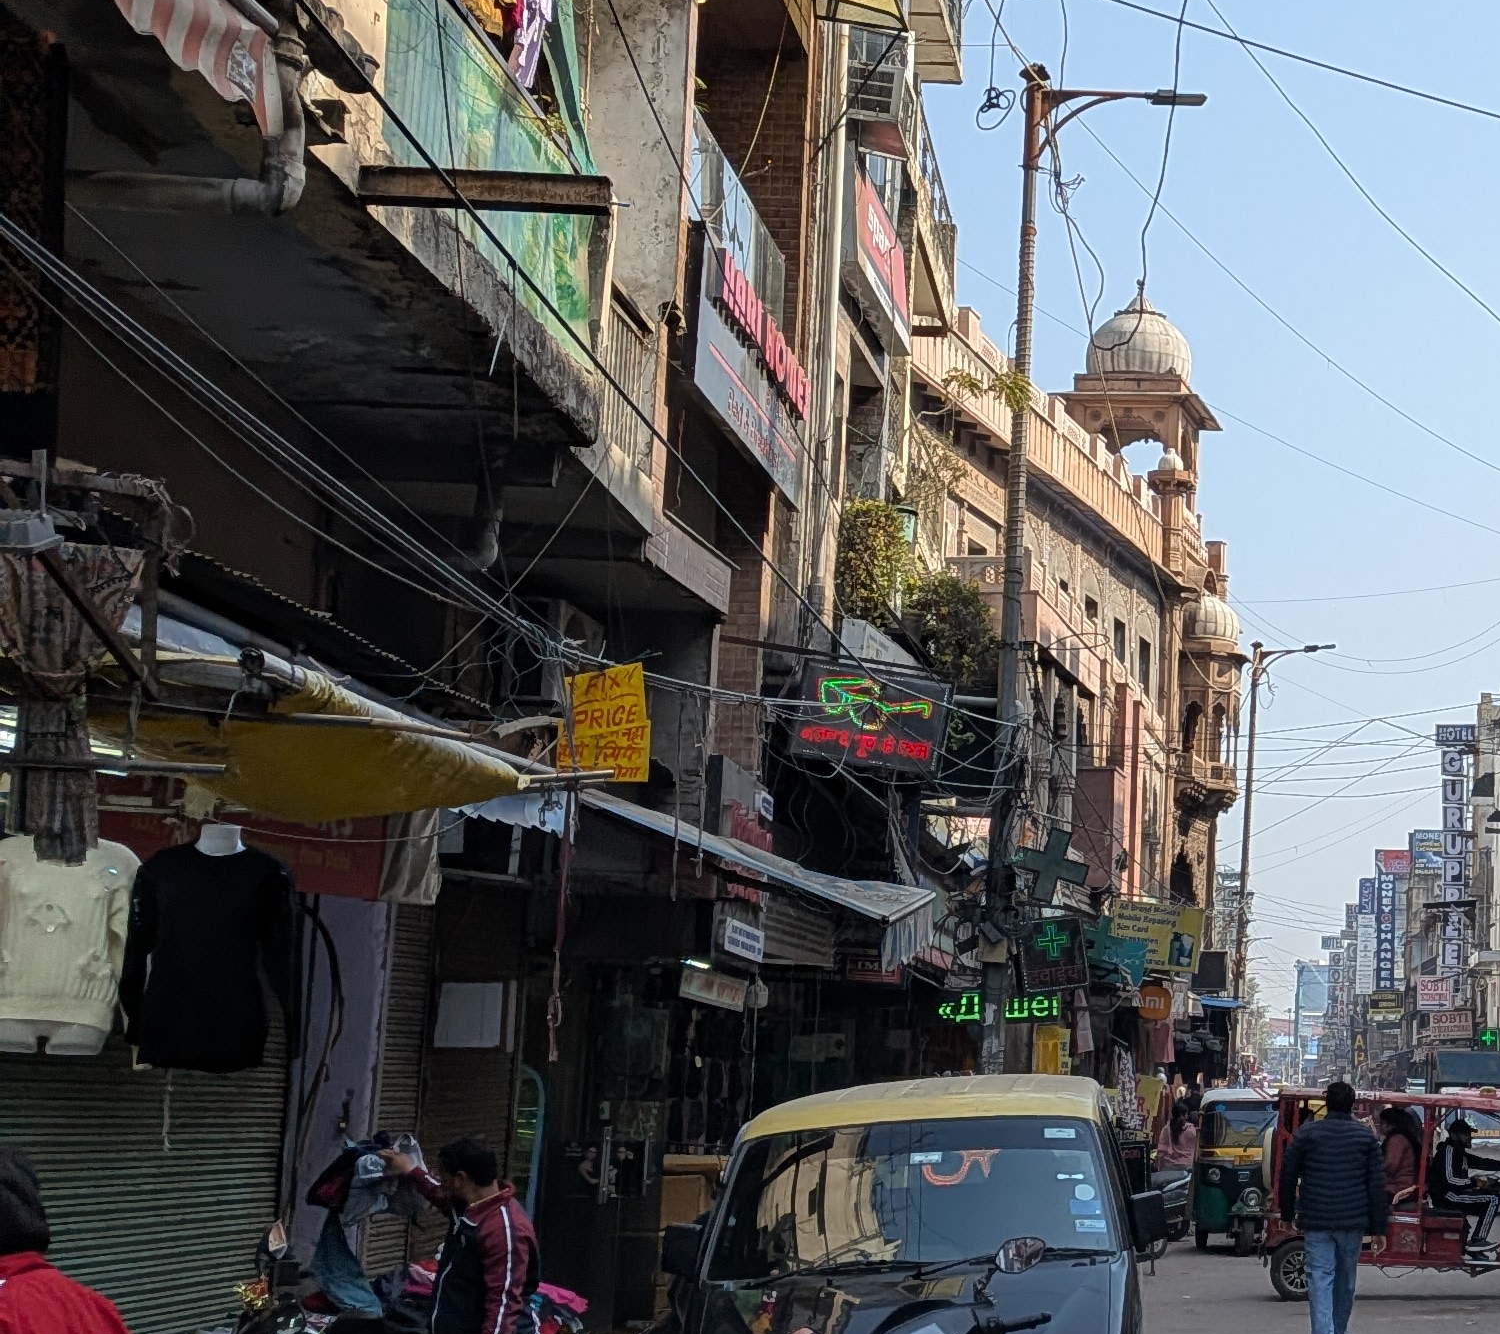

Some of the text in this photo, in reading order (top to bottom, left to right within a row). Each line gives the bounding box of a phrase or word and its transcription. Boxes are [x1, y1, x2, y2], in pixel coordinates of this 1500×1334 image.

[585, 671, 622, 697] FIX
[573, 703, 639, 730] PRICE
[1438, 726, 1474, 742] HOTEL
[1131, 924, 1150, 933] Card
[1380, 874, 1394, 988] MONEY CHANGER
[1420, 979, 1449, 992] SOBTI
[1432, 1013, 1469, 1025] SOBTI
